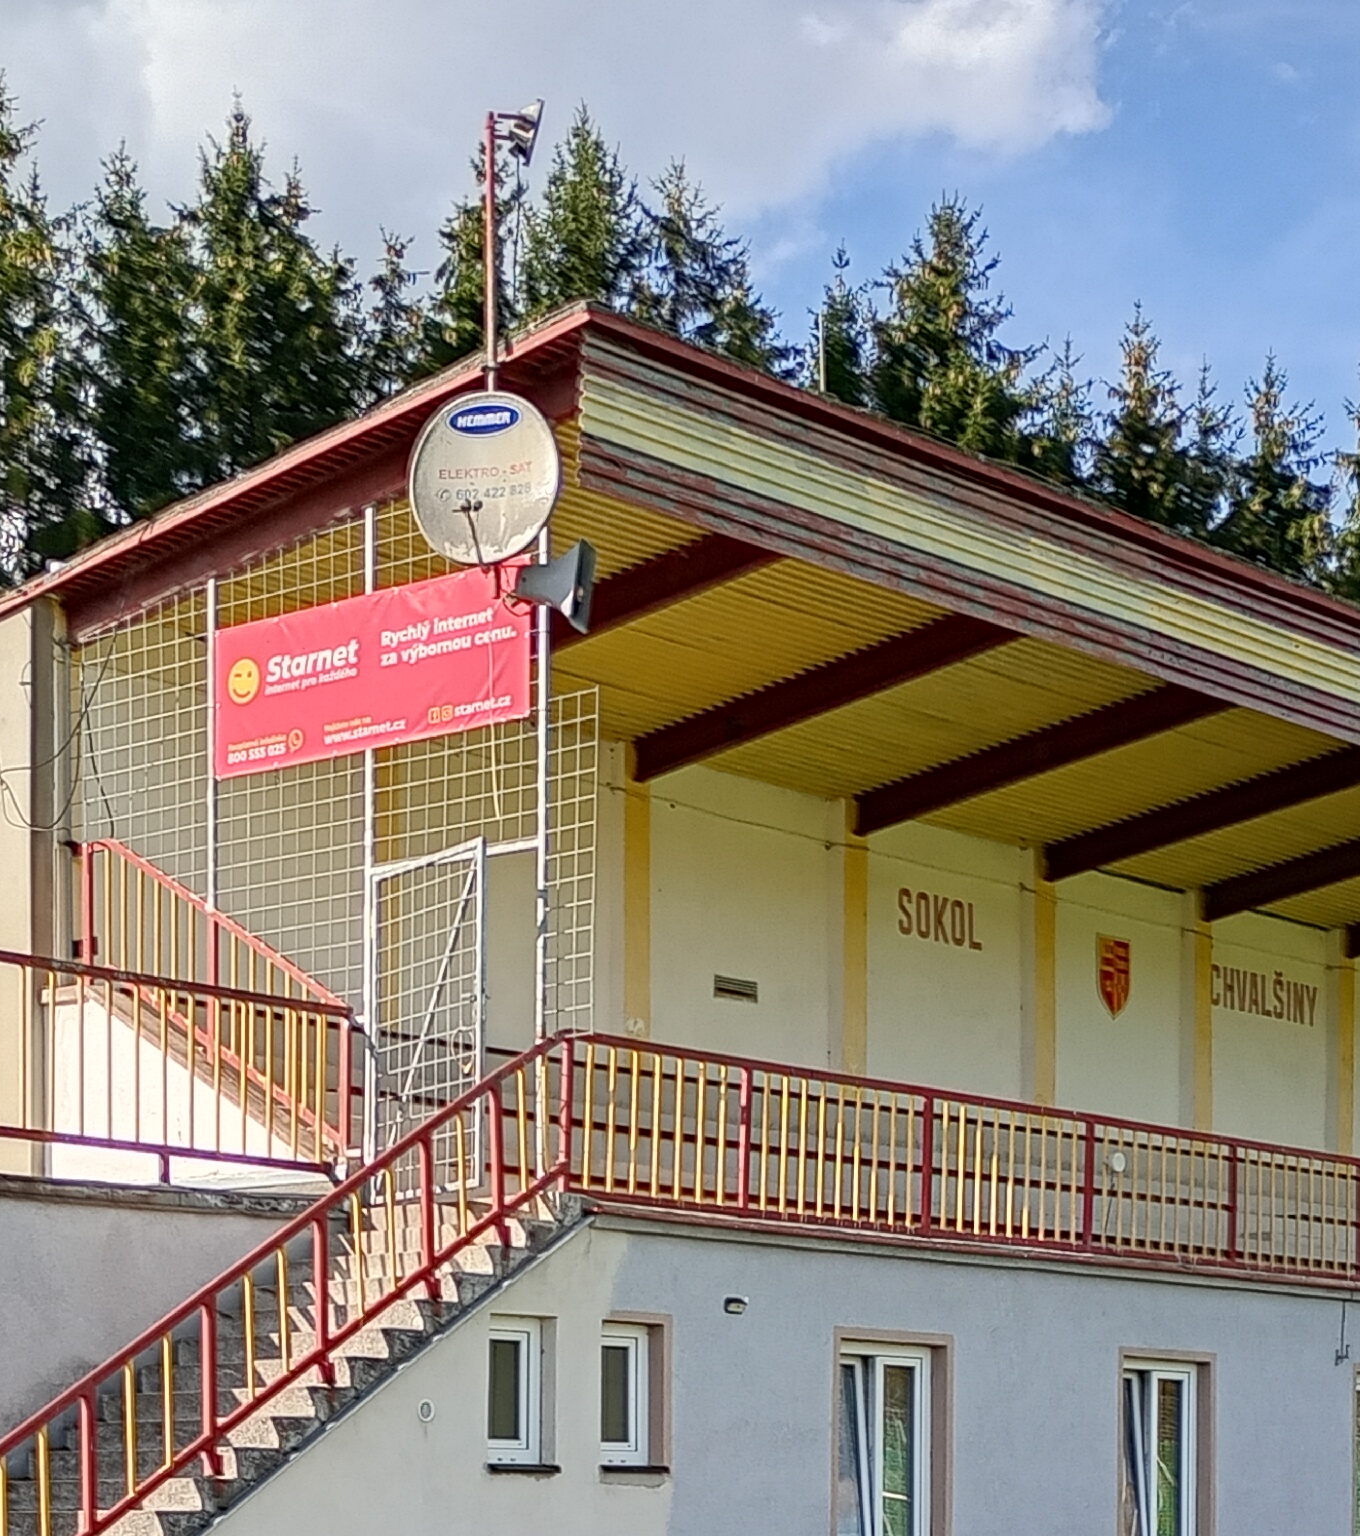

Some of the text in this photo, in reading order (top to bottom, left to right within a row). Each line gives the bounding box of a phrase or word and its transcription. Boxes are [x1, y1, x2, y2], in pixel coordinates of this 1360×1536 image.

[438, 466, 500, 480] ELEKTRO
[509, 461, 533, 475] SAT
[456, 488, 480, 501] 602
[483, 486, 506, 498] 422
[380, 607, 494, 648] Rychlý internet
[380, 625, 517, 667] za výbornou cenu.
[265, 638, 360, 682] Starnet
[264, 679, 301, 696] internet
[301, 677, 318, 691] pro
[454, 694, 512, 717] starnet.cz
[323, 718, 406, 745] www.starnet.cz
[227, 749, 247, 765] 800
[267, 742, 287, 757] 025
[897, 887, 983, 951] SOKOL
[1211, 963, 1318, 1028] CHVALŠINY
